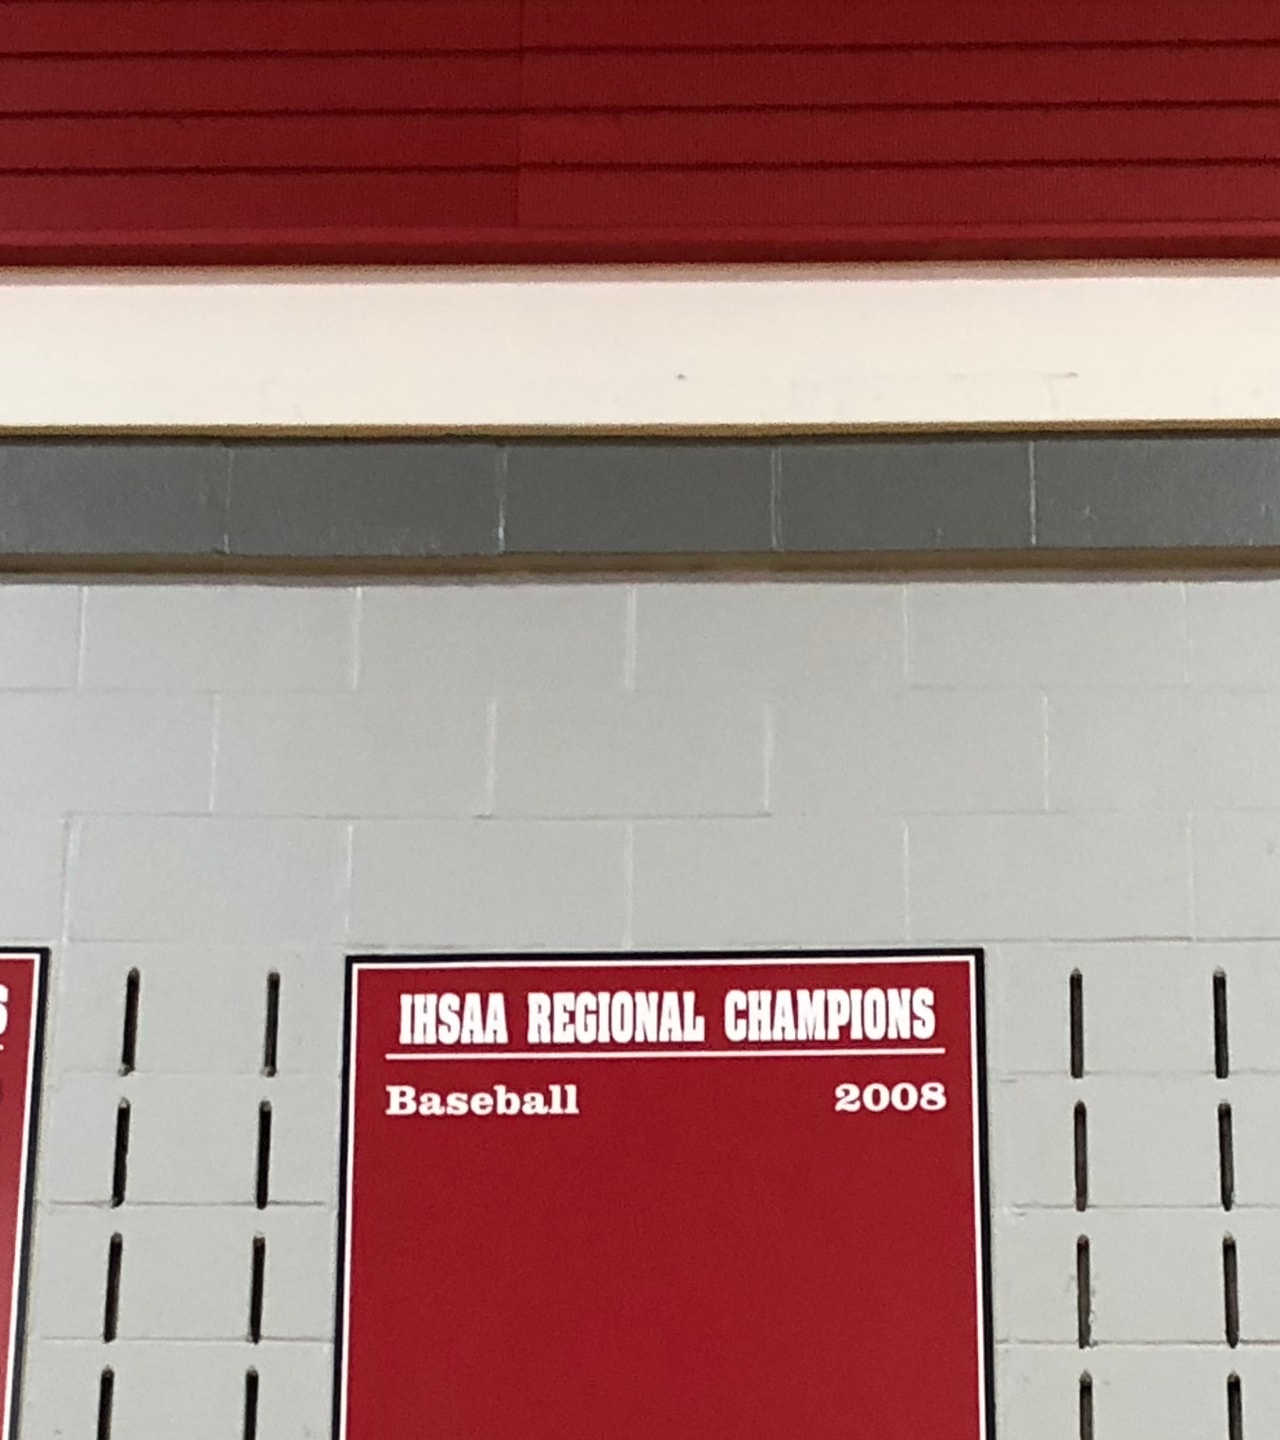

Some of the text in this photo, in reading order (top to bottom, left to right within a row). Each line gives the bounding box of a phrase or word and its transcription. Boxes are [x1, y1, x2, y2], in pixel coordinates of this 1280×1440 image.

[398, 988, 935, 1045] IHSAA REGIONAL CHAMPIONS
[385, 1082, 947, 1115] Baseball 2008
